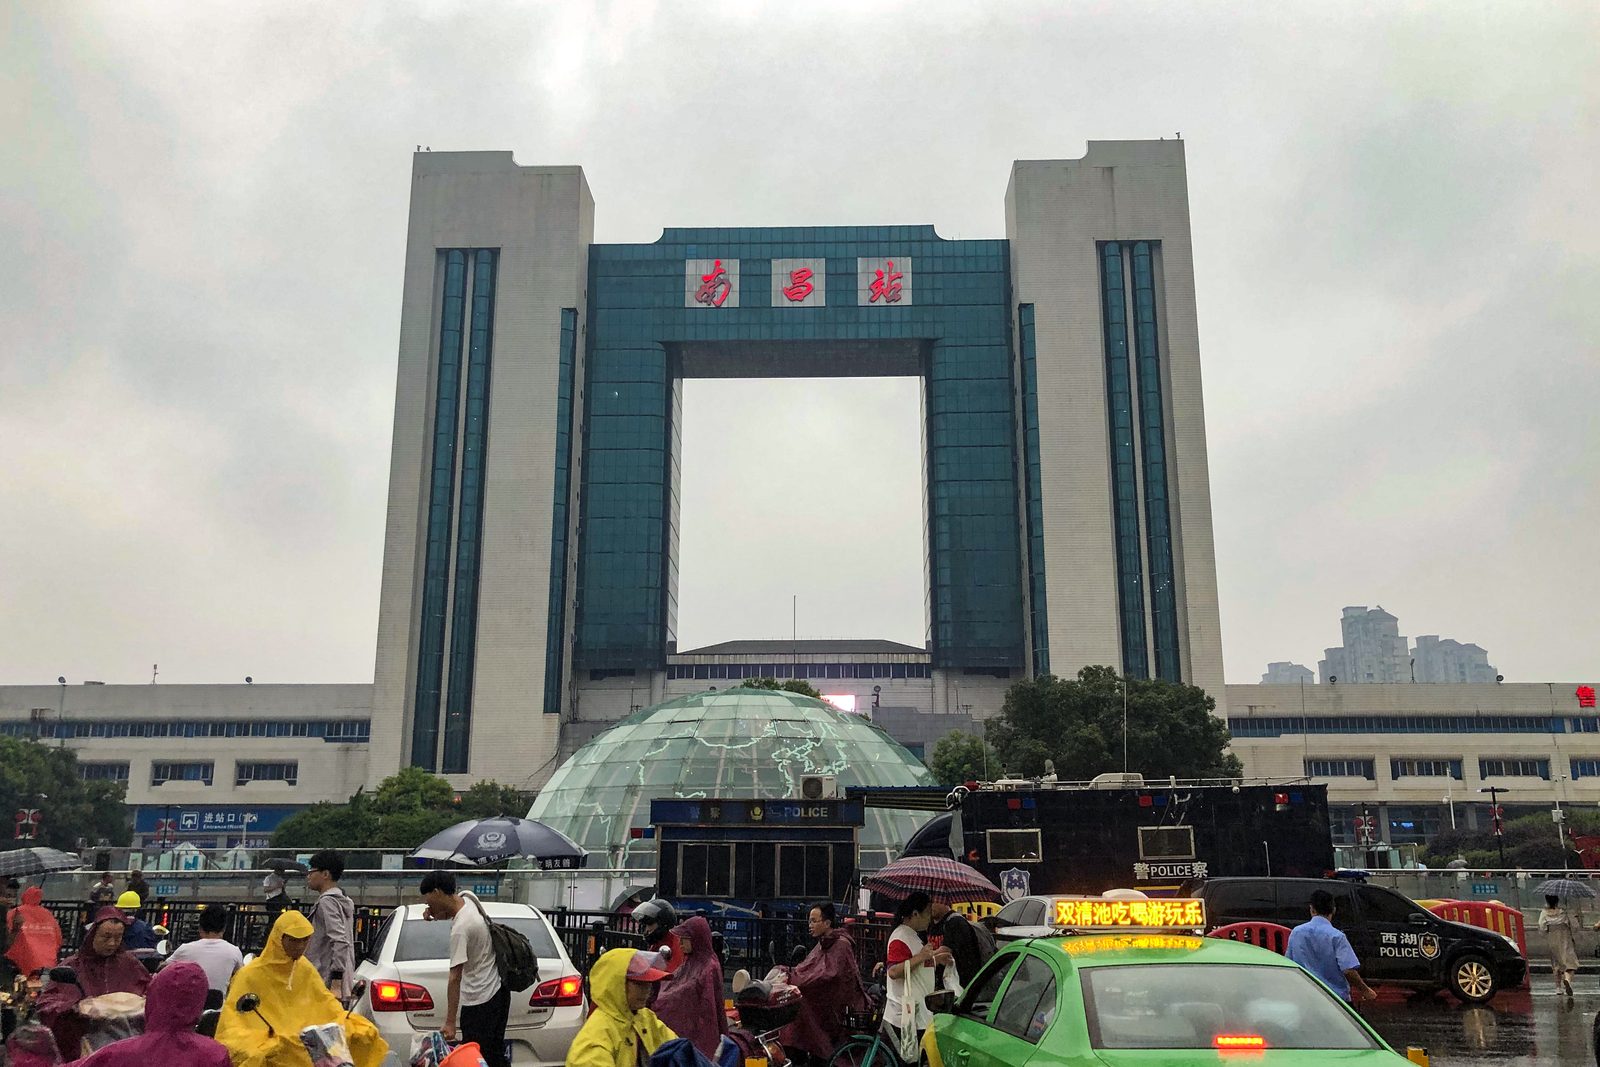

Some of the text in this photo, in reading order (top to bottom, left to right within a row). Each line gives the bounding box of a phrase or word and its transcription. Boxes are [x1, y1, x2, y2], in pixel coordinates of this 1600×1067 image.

[695, 258, 904, 308] 南昌站
[784, 806, 829, 818] POLICE
[1133, 862, 1150, 879] 警
[1150, 865, 1192, 877] POLICE
[1191, 861, 1208, 879] 察
[1056, 901, 1203, 926] 双清池吃喝游玩乐
[1380, 932, 1417, 945] 西湖
[1380, 947, 1419, 958] POLICE
